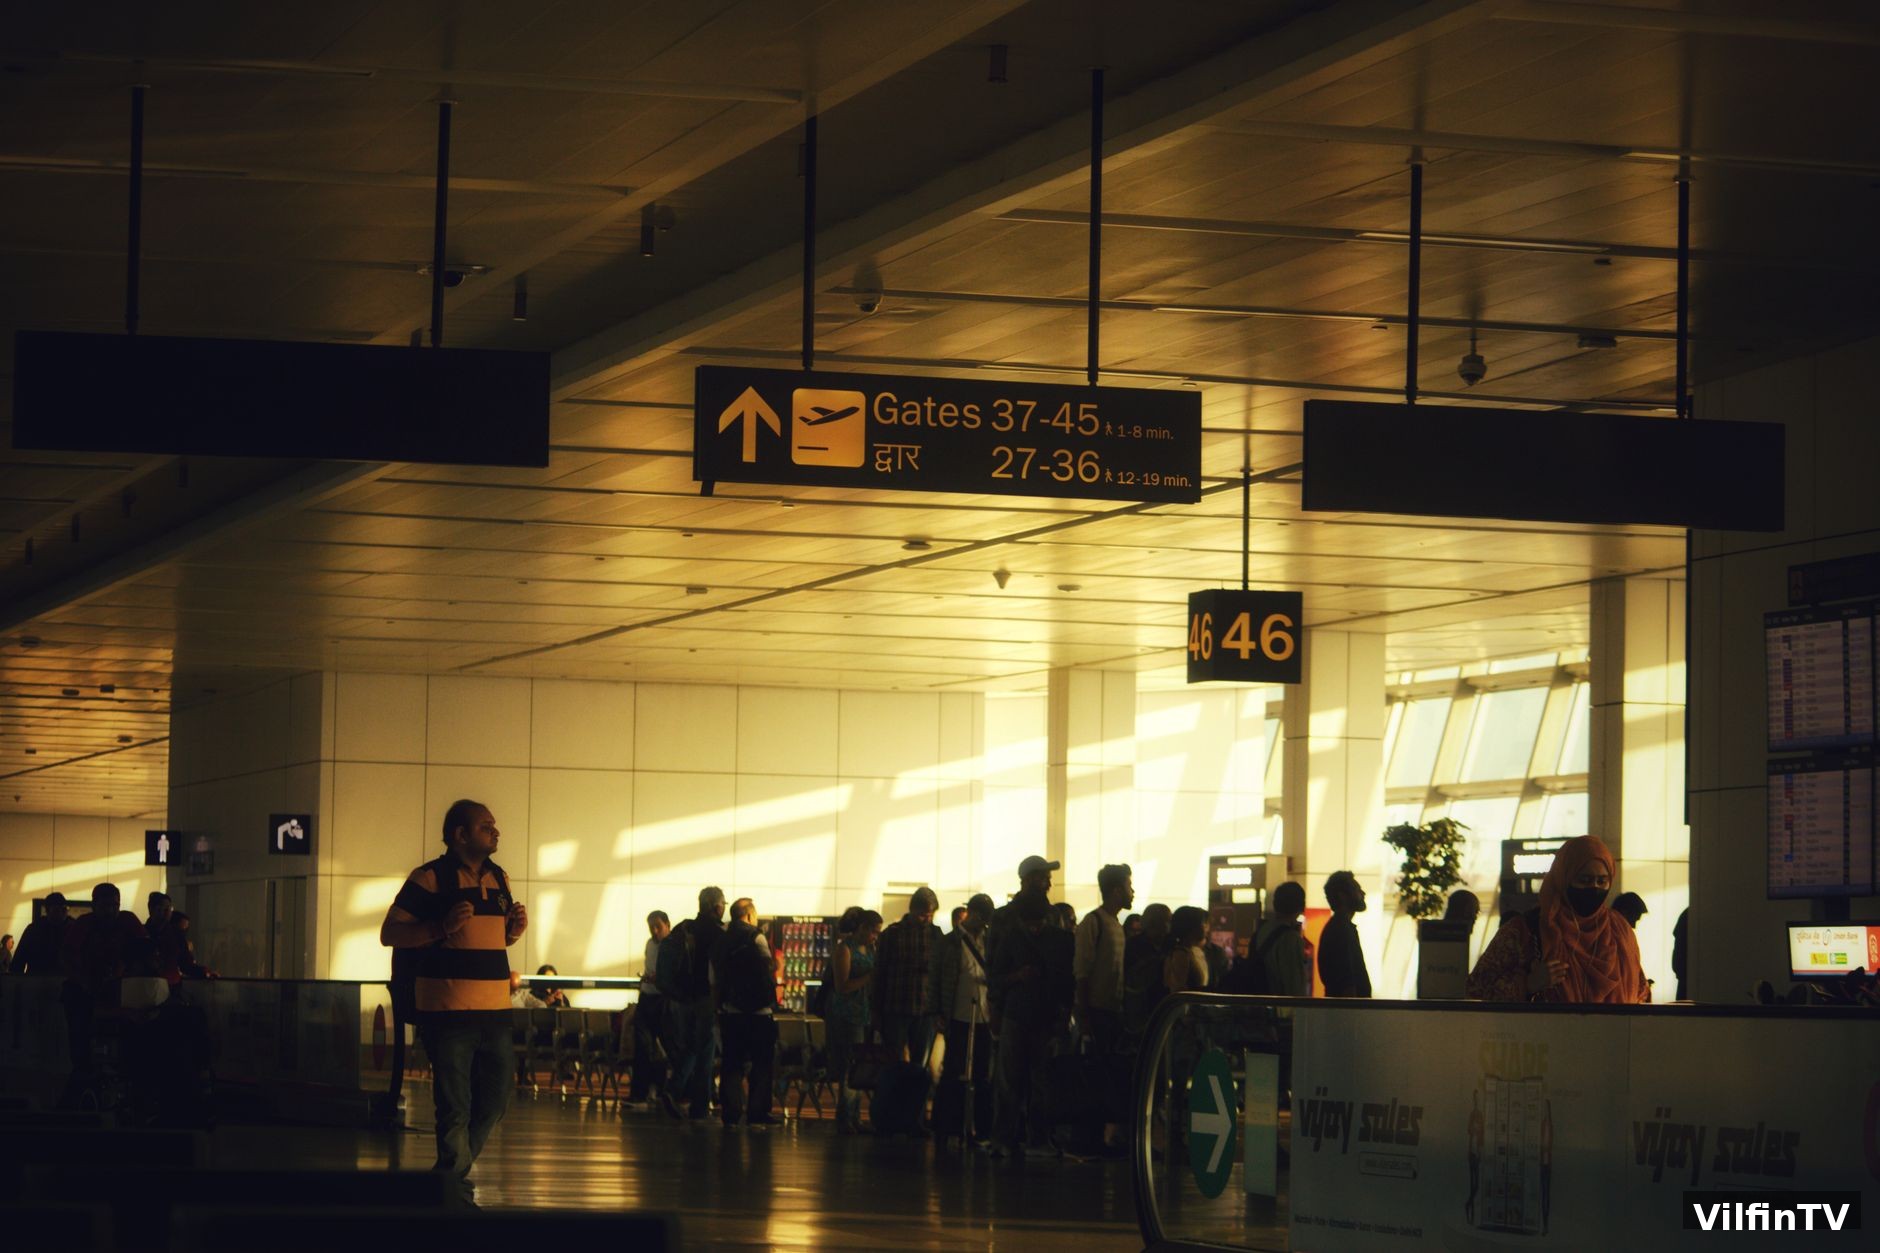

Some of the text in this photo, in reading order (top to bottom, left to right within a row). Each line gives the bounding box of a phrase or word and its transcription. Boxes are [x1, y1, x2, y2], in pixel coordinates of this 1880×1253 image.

[873, 391, 1174, 440] Gates 37-45 1-8 min.
[873, 443, 922, 473] द्वार
[991, 445, 1192, 488] 27-36 12-19 min.
[1188, 611, 1213, 662] 46
[1221, 611, 1295, 662] 46
